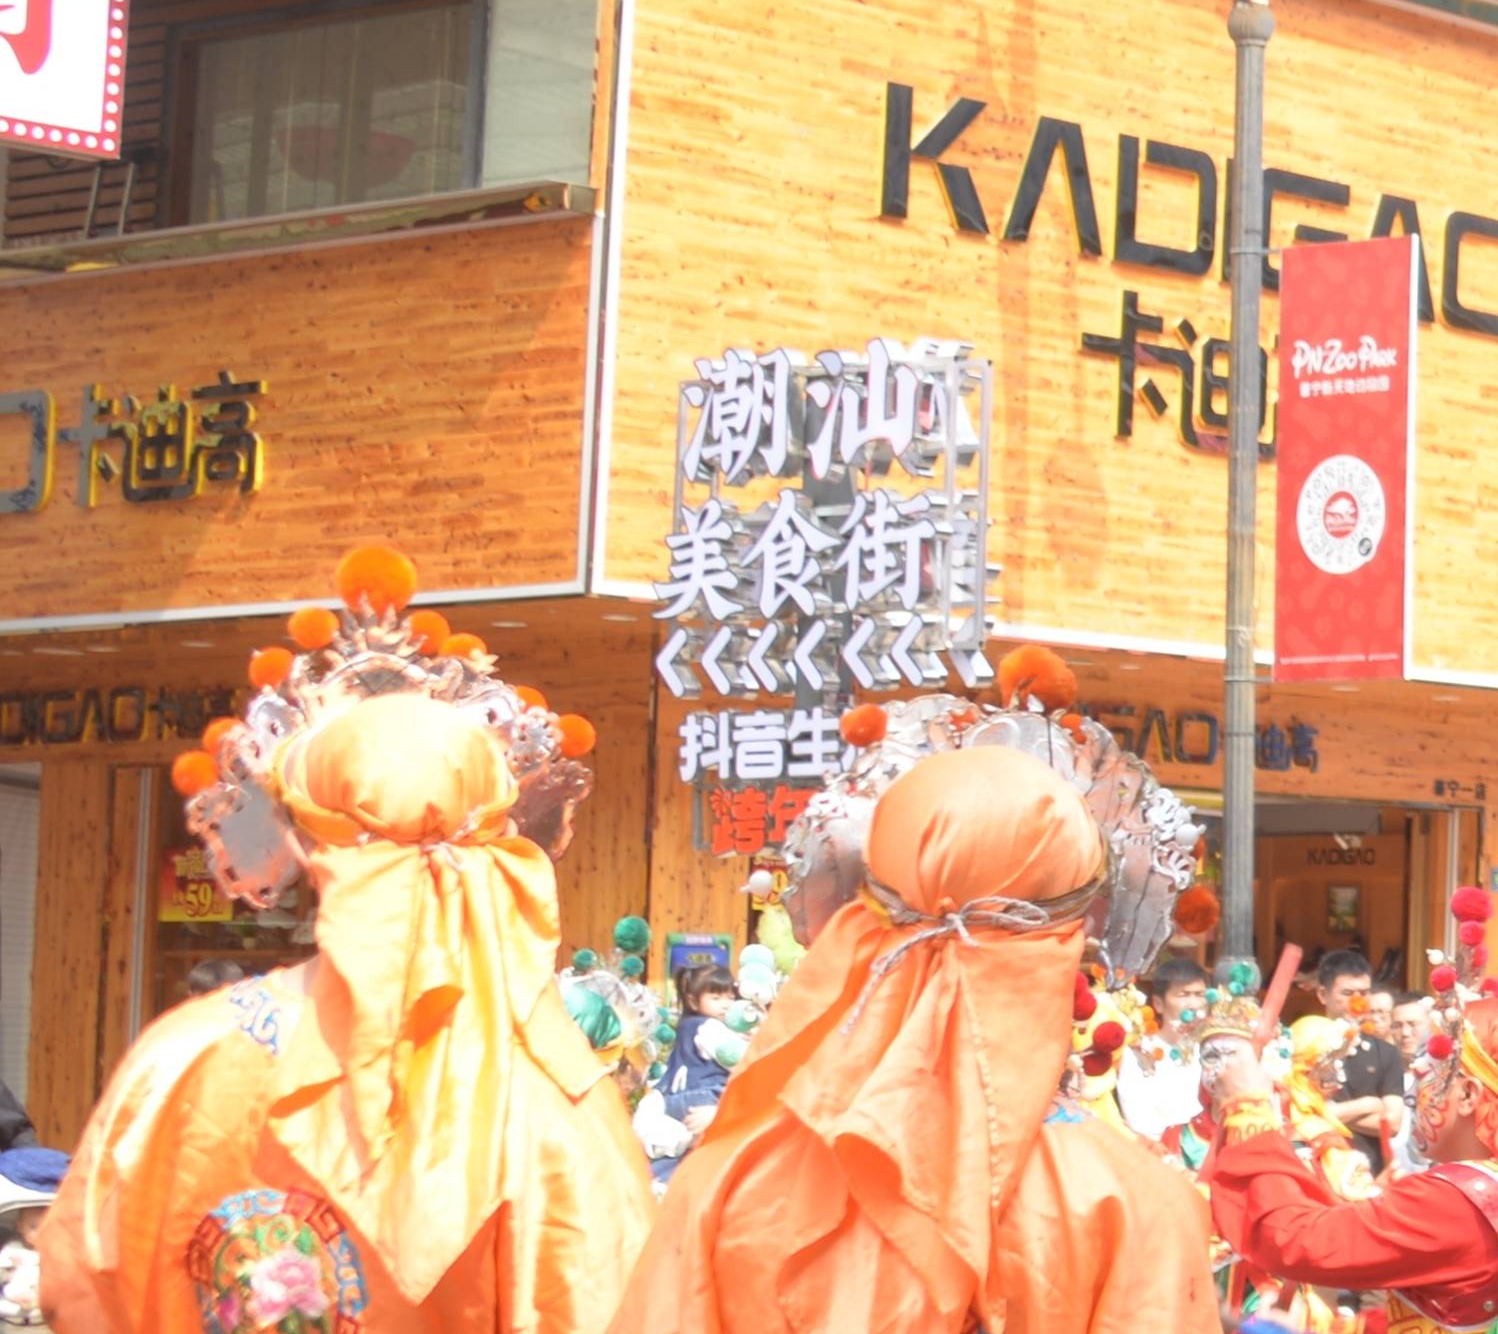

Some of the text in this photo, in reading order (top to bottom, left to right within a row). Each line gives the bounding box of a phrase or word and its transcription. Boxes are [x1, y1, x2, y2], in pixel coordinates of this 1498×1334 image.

[682, 338, 920, 482] 潮汕
[652, 488, 937, 620] 美食街
[680, 708, 857, 782] 抖音生
